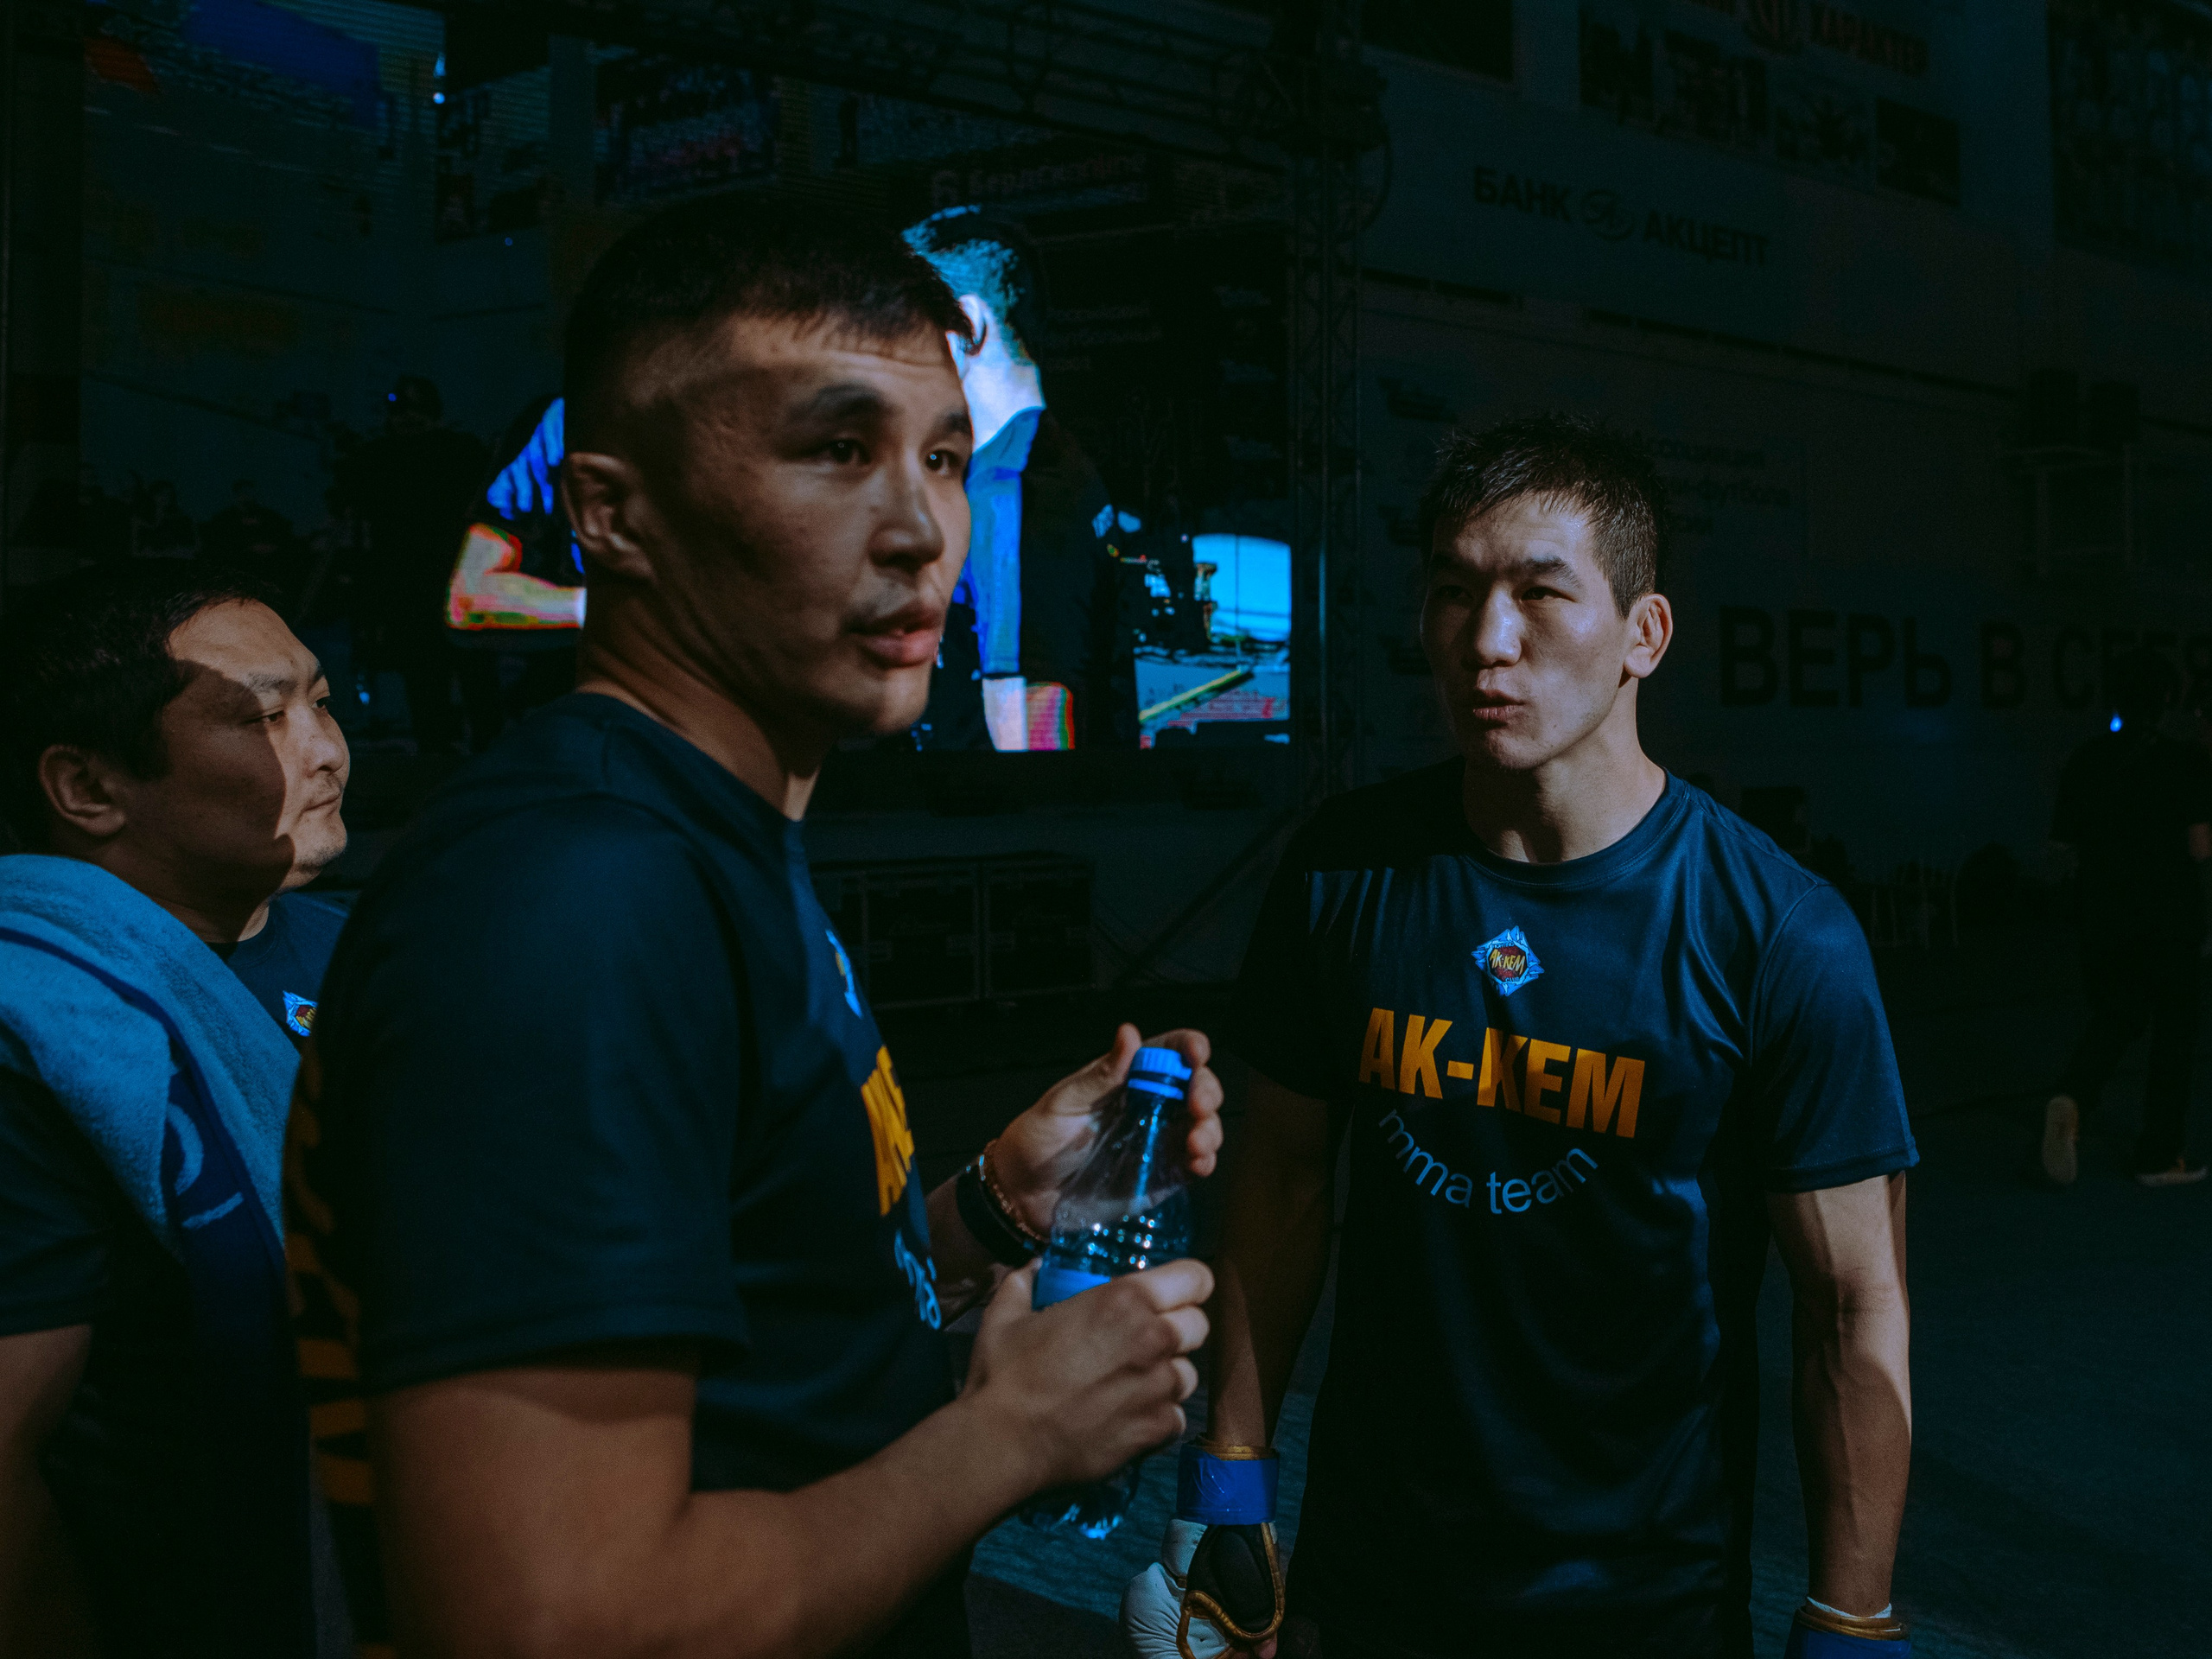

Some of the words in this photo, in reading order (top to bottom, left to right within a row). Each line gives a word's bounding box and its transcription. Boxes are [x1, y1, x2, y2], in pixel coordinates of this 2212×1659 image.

[1472, 164, 1571, 223] БАНК
[1643, 208, 1769, 267] АКЦЕПТ
[1719, 604, 1954, 709] ВЕРЬ
[1980, 620, 2028, 710] В
[1357, 1007, 1646, 1140] AK-KEM
[1378, 1108, 1473, 1209] mma
[1485, 1147, 1599, 1216] team
